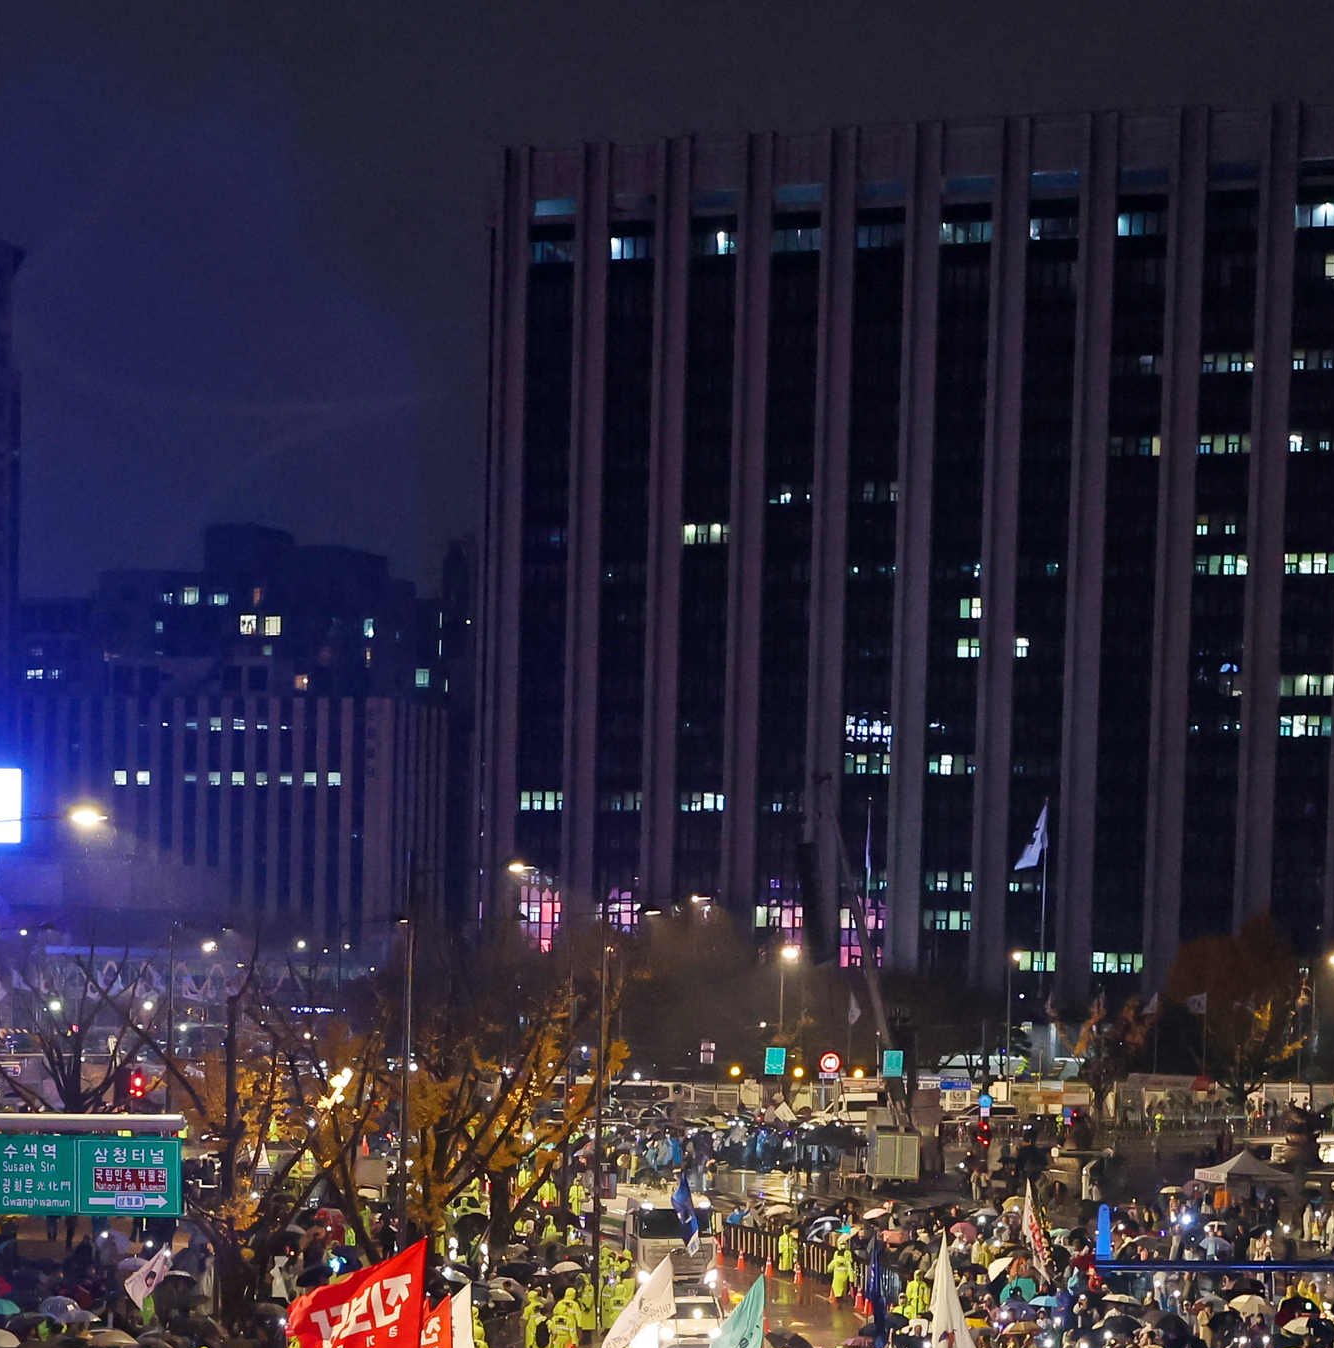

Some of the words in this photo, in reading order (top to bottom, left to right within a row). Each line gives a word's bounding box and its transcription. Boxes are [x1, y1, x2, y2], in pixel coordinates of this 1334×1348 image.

[3, 1143, 57, 1160] 수색역
[94, 1148, 165, 1164] 삼청터널
[2, 1161, 36, 1173] Susaek
[138, 1169, 166, 1183] 박물관
[2, 1178, 33, 1194] 광화문
[2, 1196, 71, 1209] Gwanghwamun
